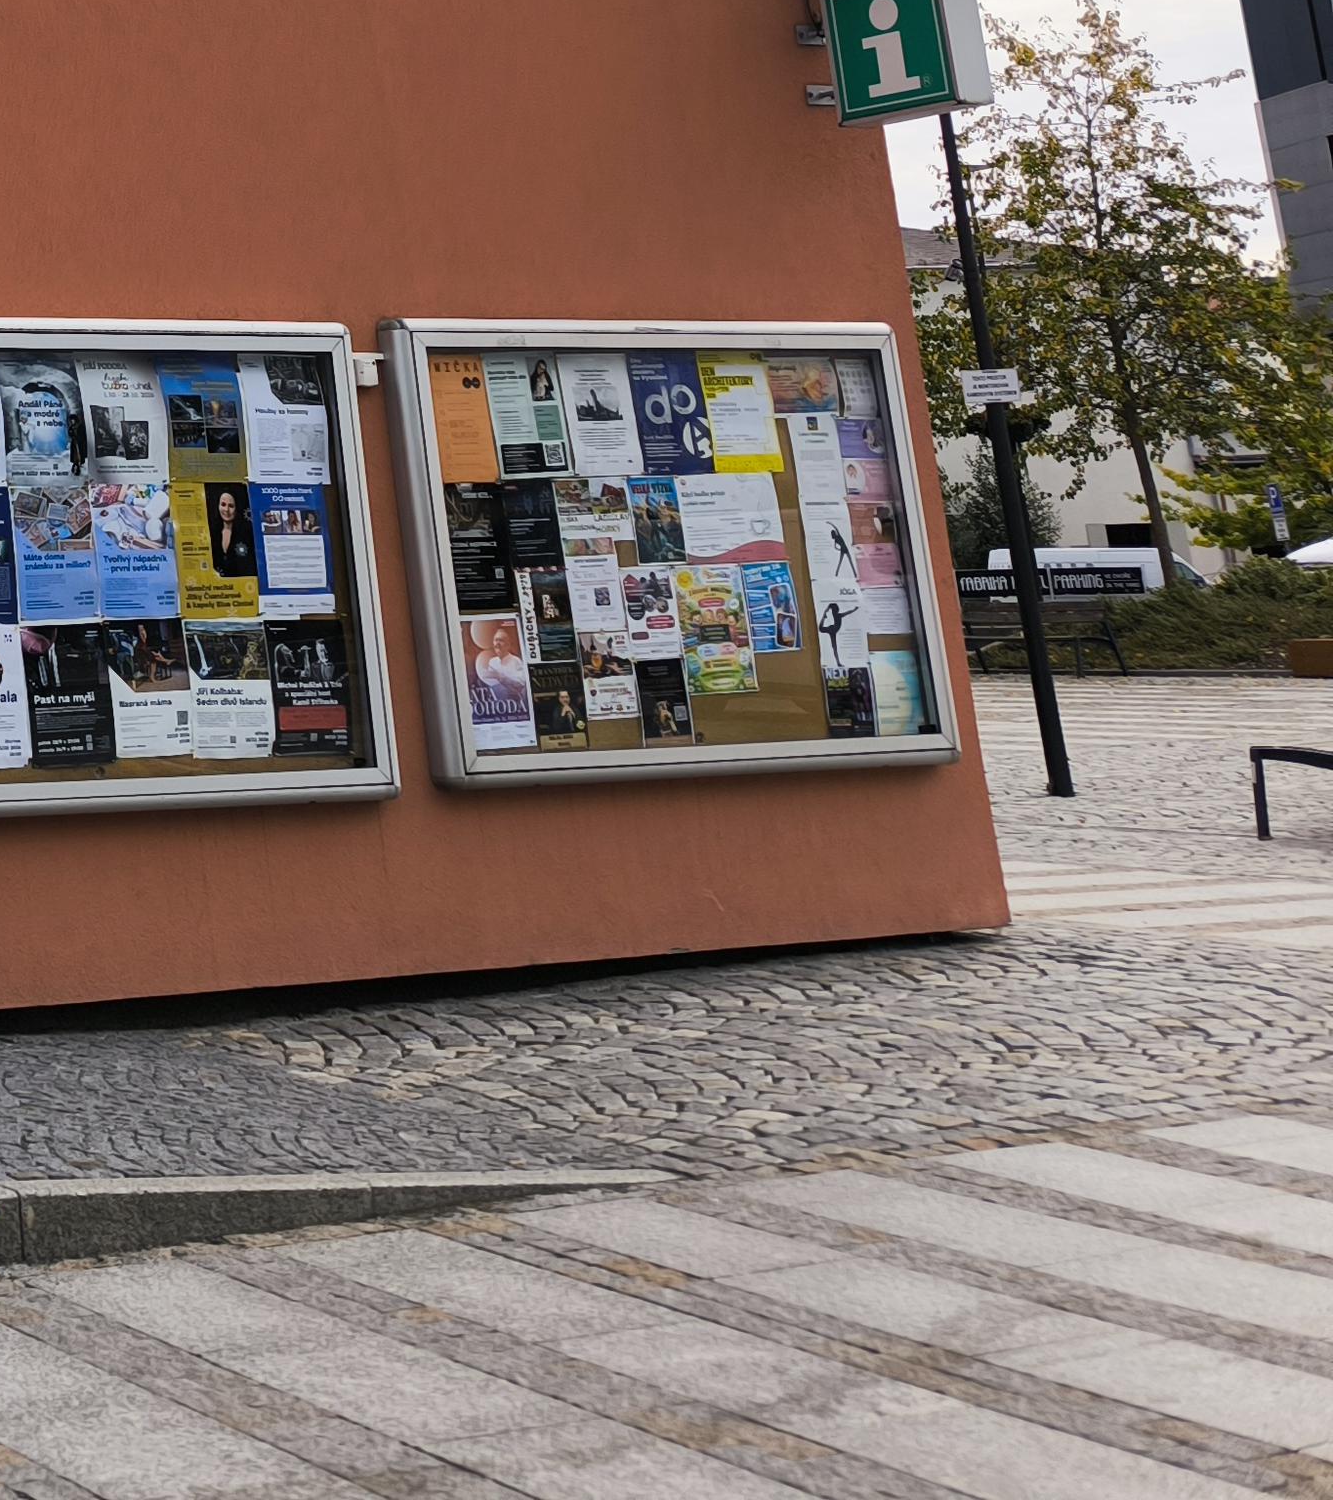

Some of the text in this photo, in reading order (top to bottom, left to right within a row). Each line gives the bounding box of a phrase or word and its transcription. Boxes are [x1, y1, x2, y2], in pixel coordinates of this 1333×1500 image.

[1054, 573, 1104, 590] PARKING
[34, 695, 55, 705] Past
[58, 695, 71, 704] na
